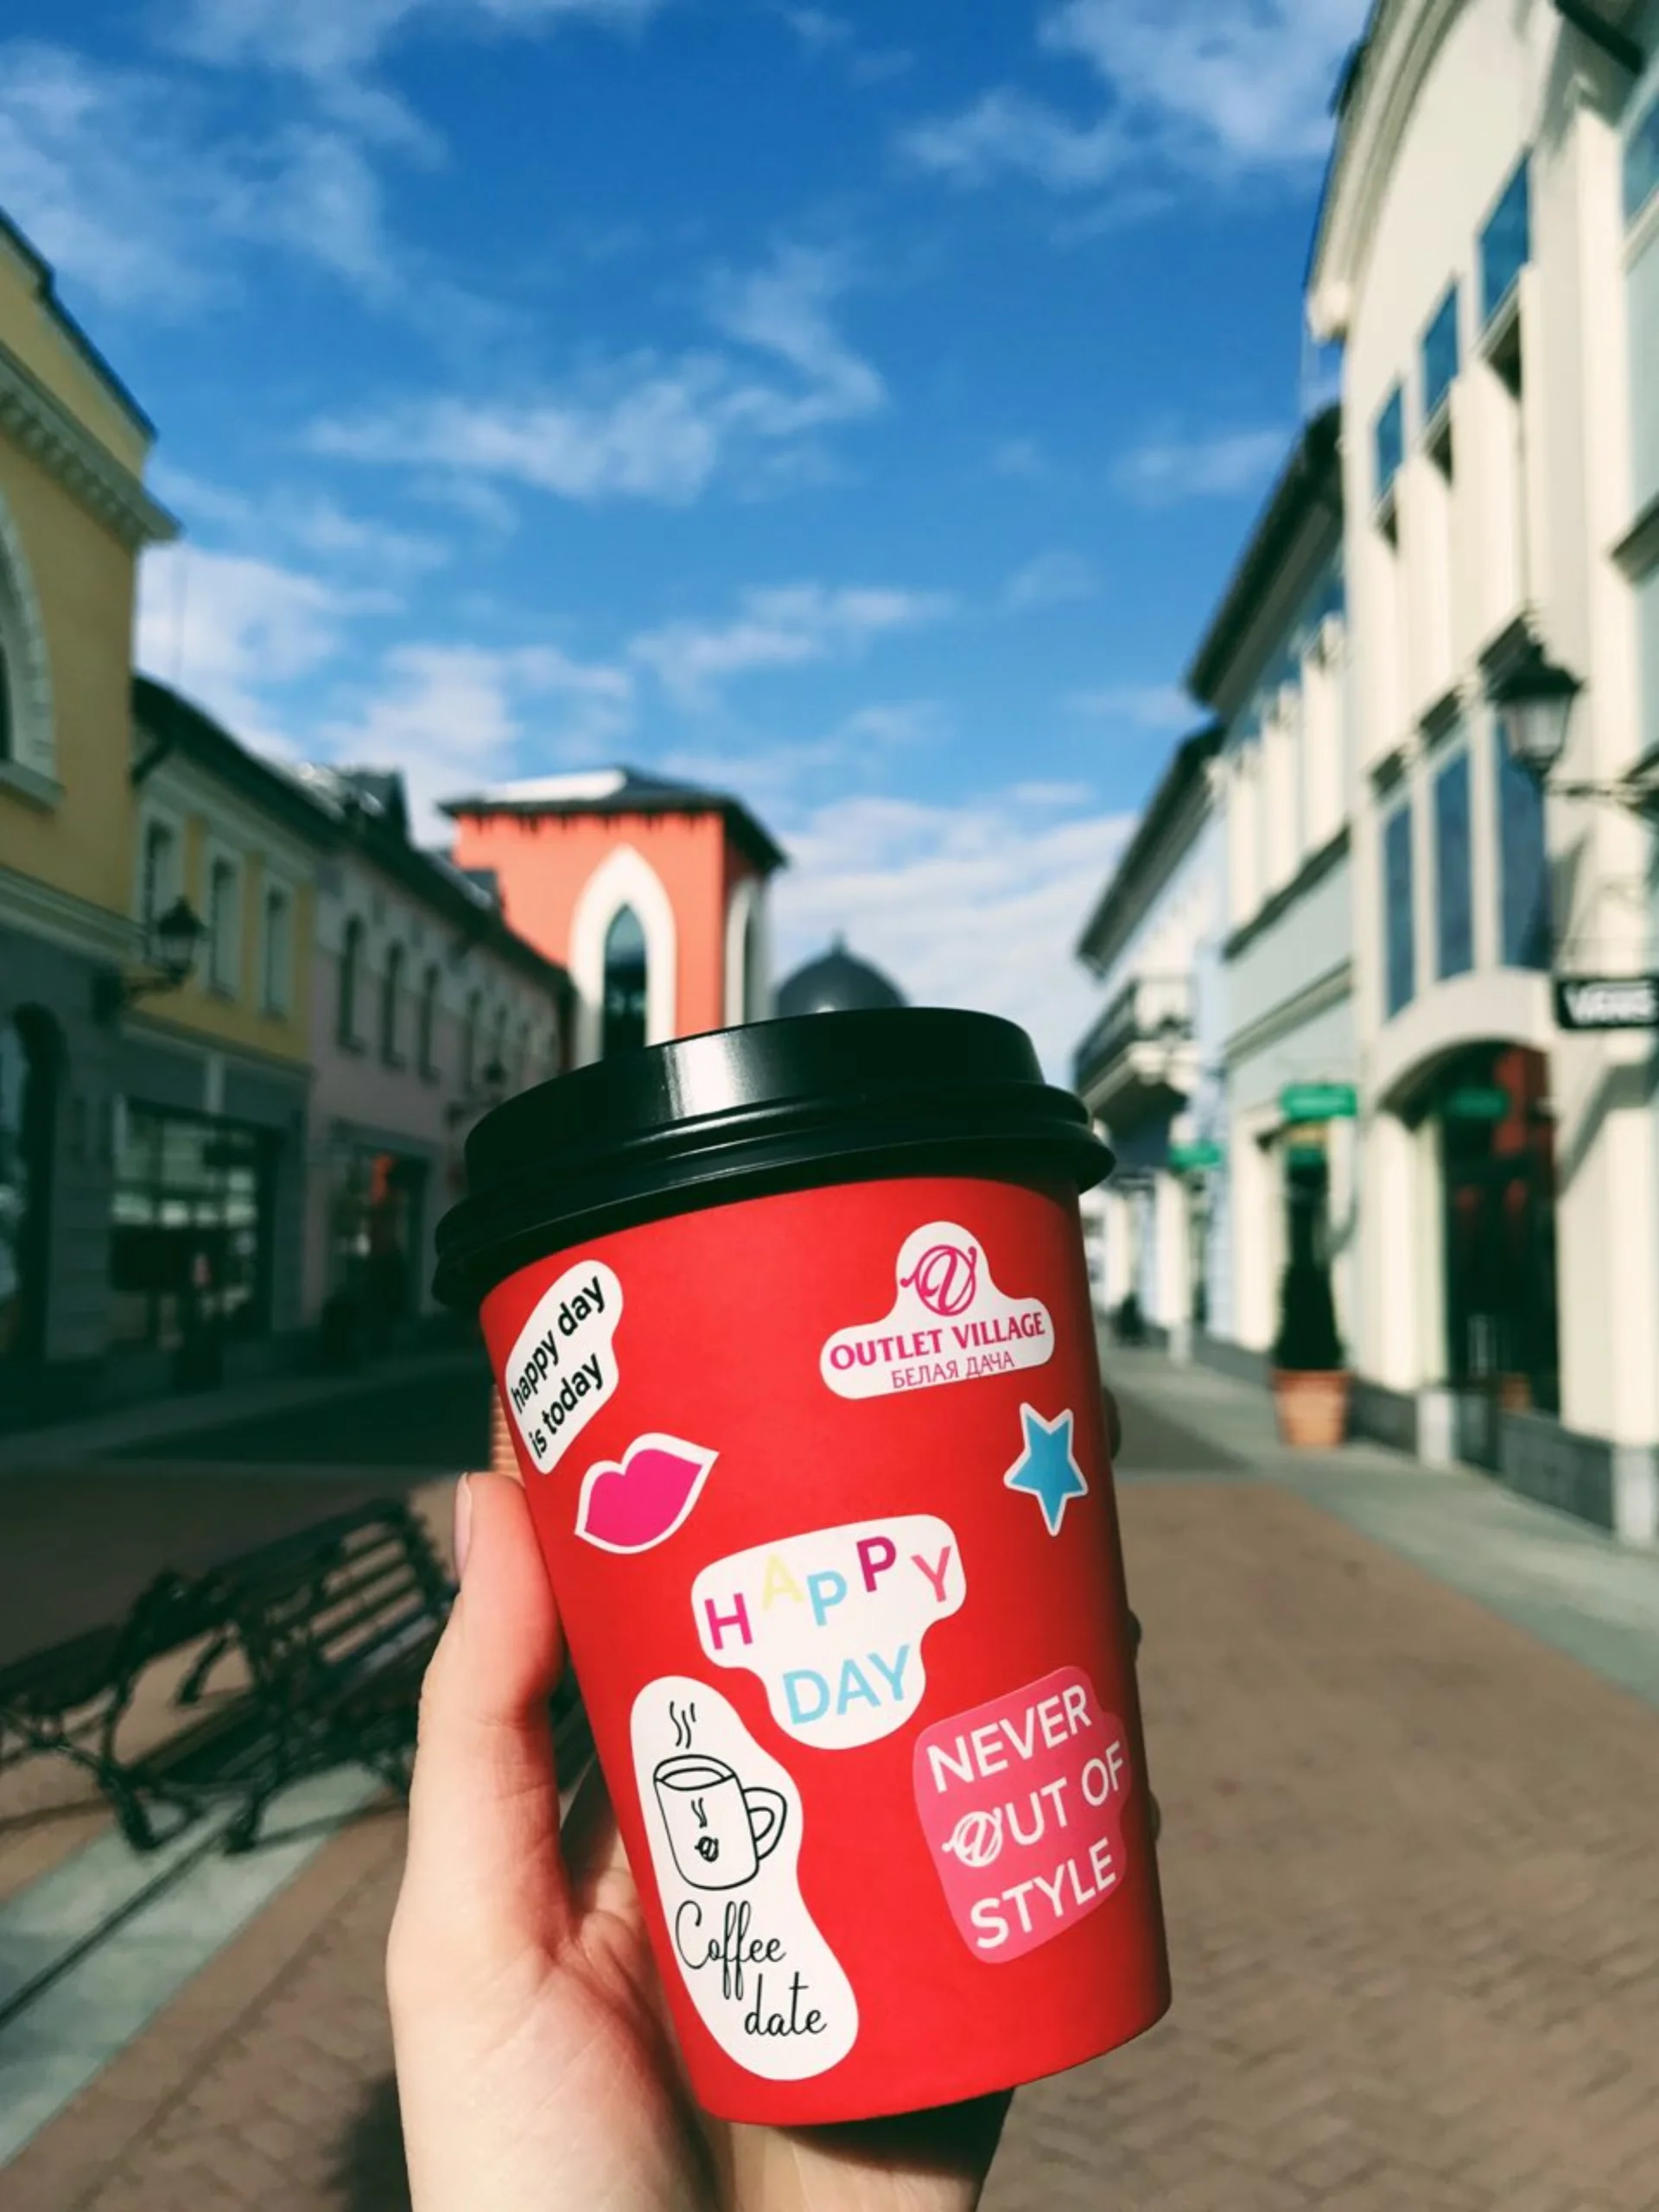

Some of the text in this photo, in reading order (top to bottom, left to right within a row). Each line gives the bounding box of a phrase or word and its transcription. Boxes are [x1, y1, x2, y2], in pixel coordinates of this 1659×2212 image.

[511, 1276, 605, 1414] happy day
[830, 1312, 1045, 1370] OUTLET VILLAGE
[892, 1351, 1015, 1389] БЕЛАЯ ДАЧА
[529, 1353, 602, 1459] is today
[704, 1536, 951, 1649] HAPPY
[782, 1644, 910, 1725] DAY
[927, 1685, 1093, 1794] NEVER
[1081, 1740, 1123, 1808] OF
[969, 1837, 1116, 1949] STYLE
[675, 1900, 786, 2001] Coffee
[744, 1971, 827, 2037] date
